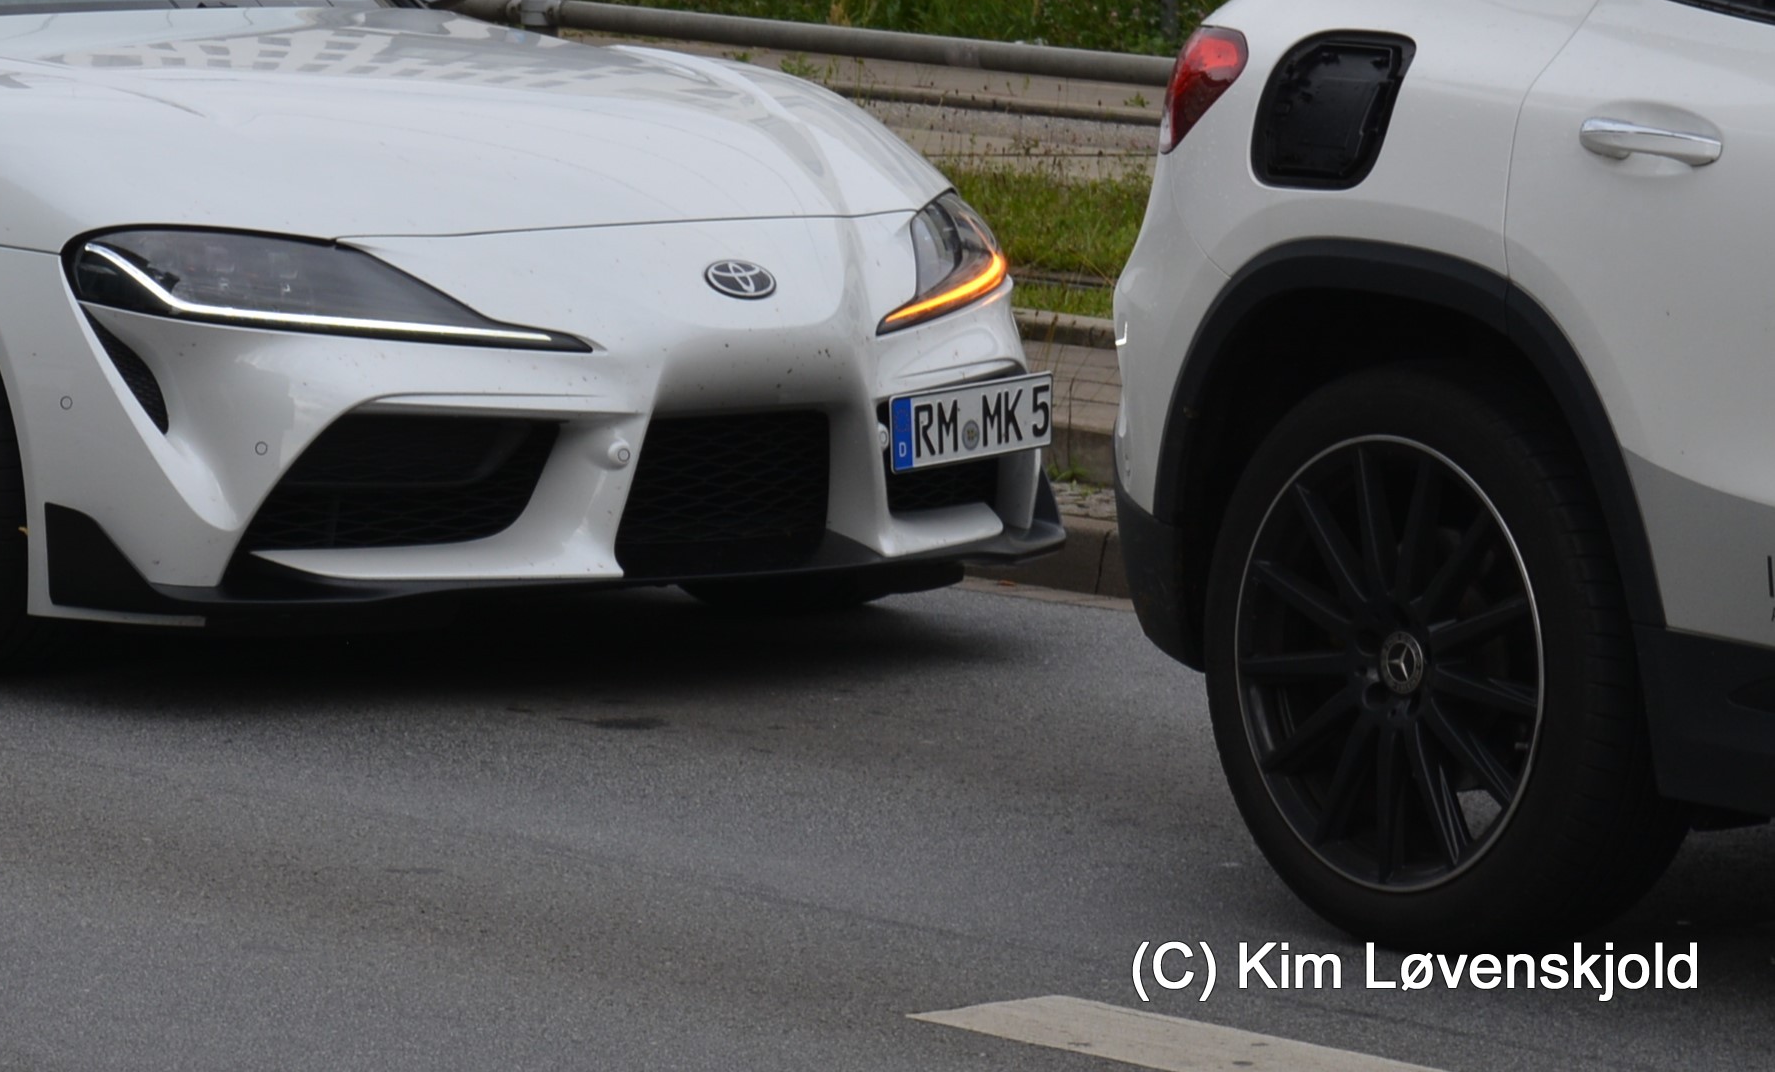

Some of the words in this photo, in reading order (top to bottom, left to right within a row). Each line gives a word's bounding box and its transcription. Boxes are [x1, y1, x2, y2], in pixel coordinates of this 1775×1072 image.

[914, 399, 959, 459] RM
[982, 389, 1023, 448] MK
[1032, 384, 1050, 438] 5
[898, 442, 907, 458] D
